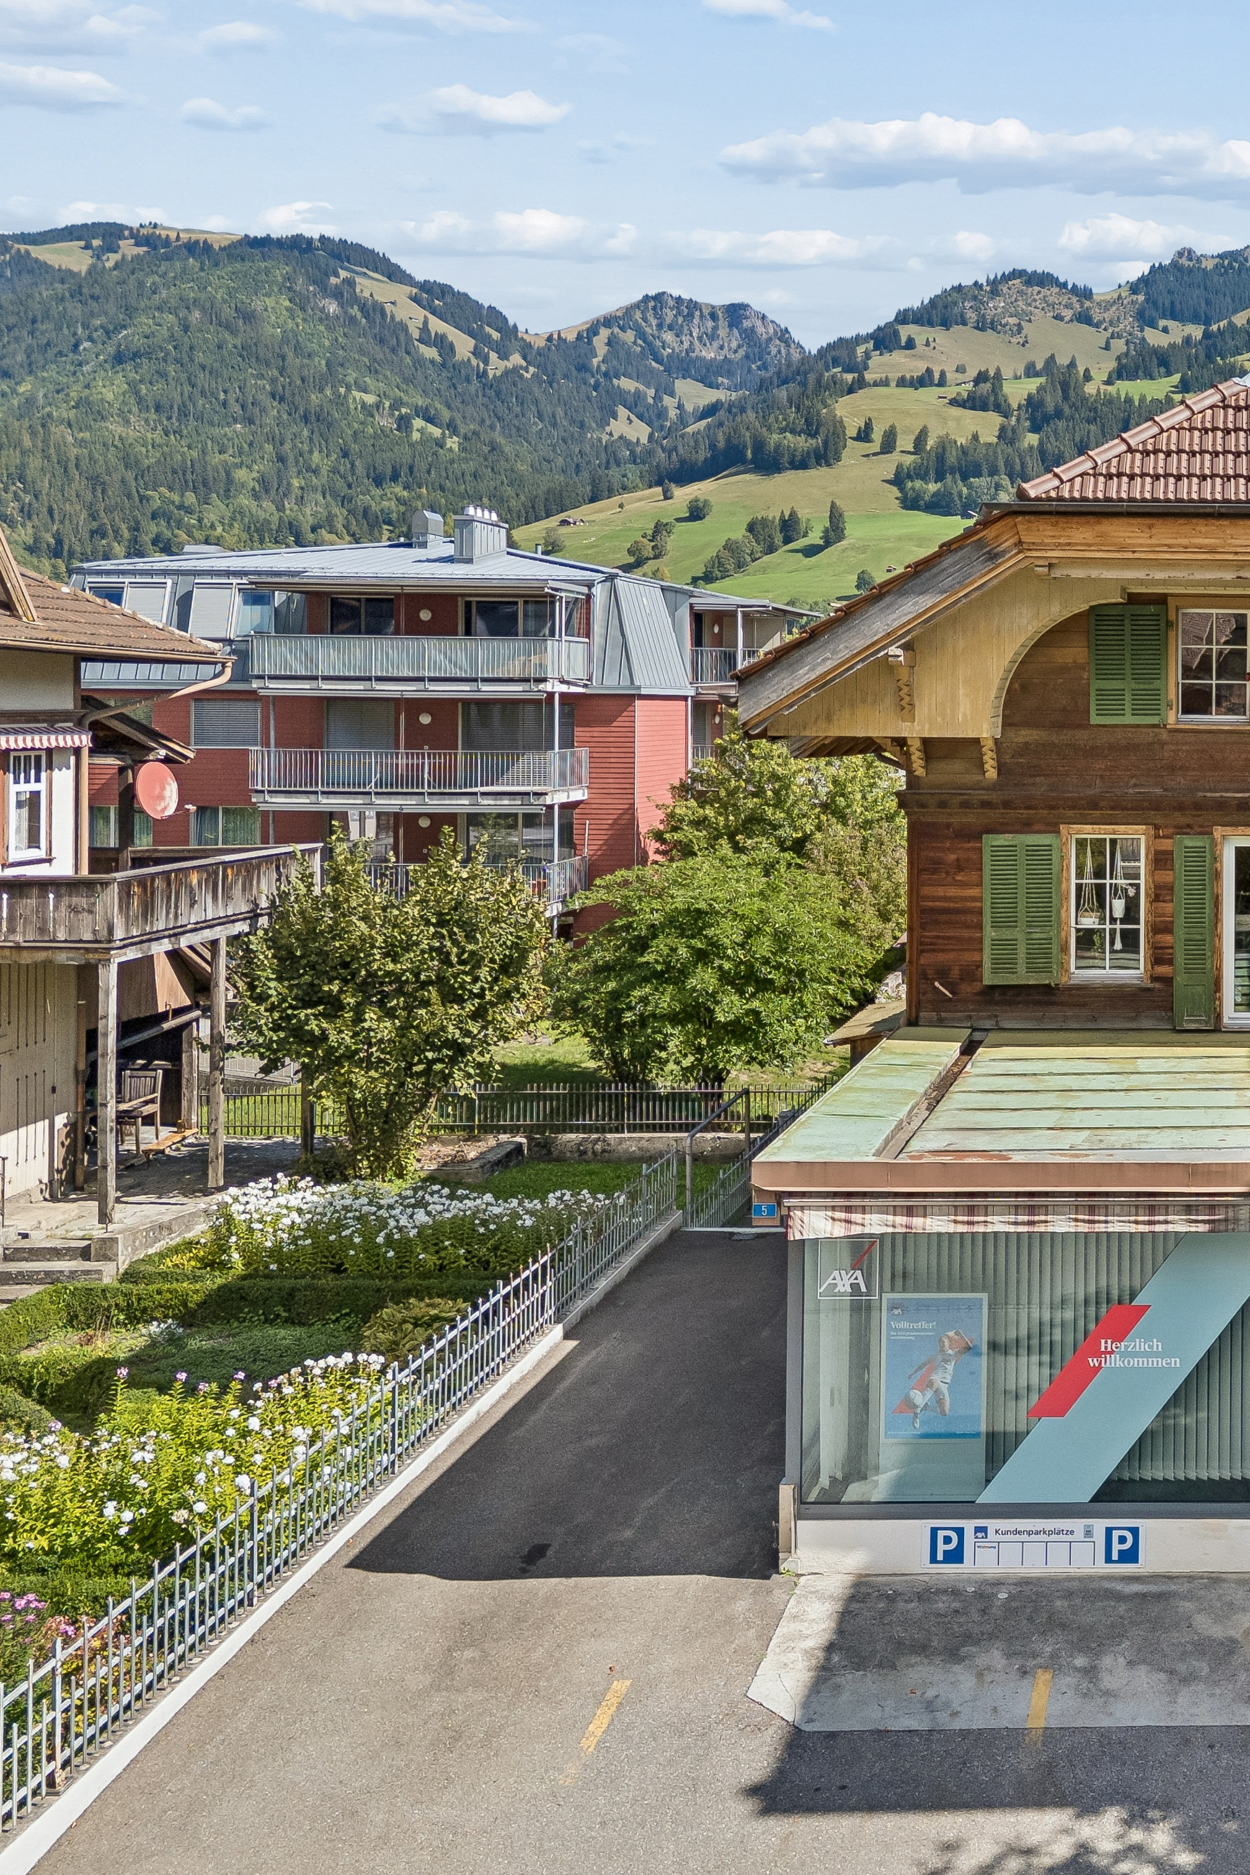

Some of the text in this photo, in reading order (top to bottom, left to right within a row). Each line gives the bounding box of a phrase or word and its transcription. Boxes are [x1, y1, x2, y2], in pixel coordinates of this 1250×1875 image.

[761, 1204, 768, 1216] 5
[819, 1269, 868, 1293] AXA
[890, 1321, 937, 1329] Volltreffer!
[1100, 1338, 1163, 1352] Herzlich
[1087, 1354, 1181, 1368] willkommen
[994, 1527, 1075, 1538] Kundenparkplätze
[936, 1529, 959, 1561] P
[1111, 1529, 1134, 1561] P
